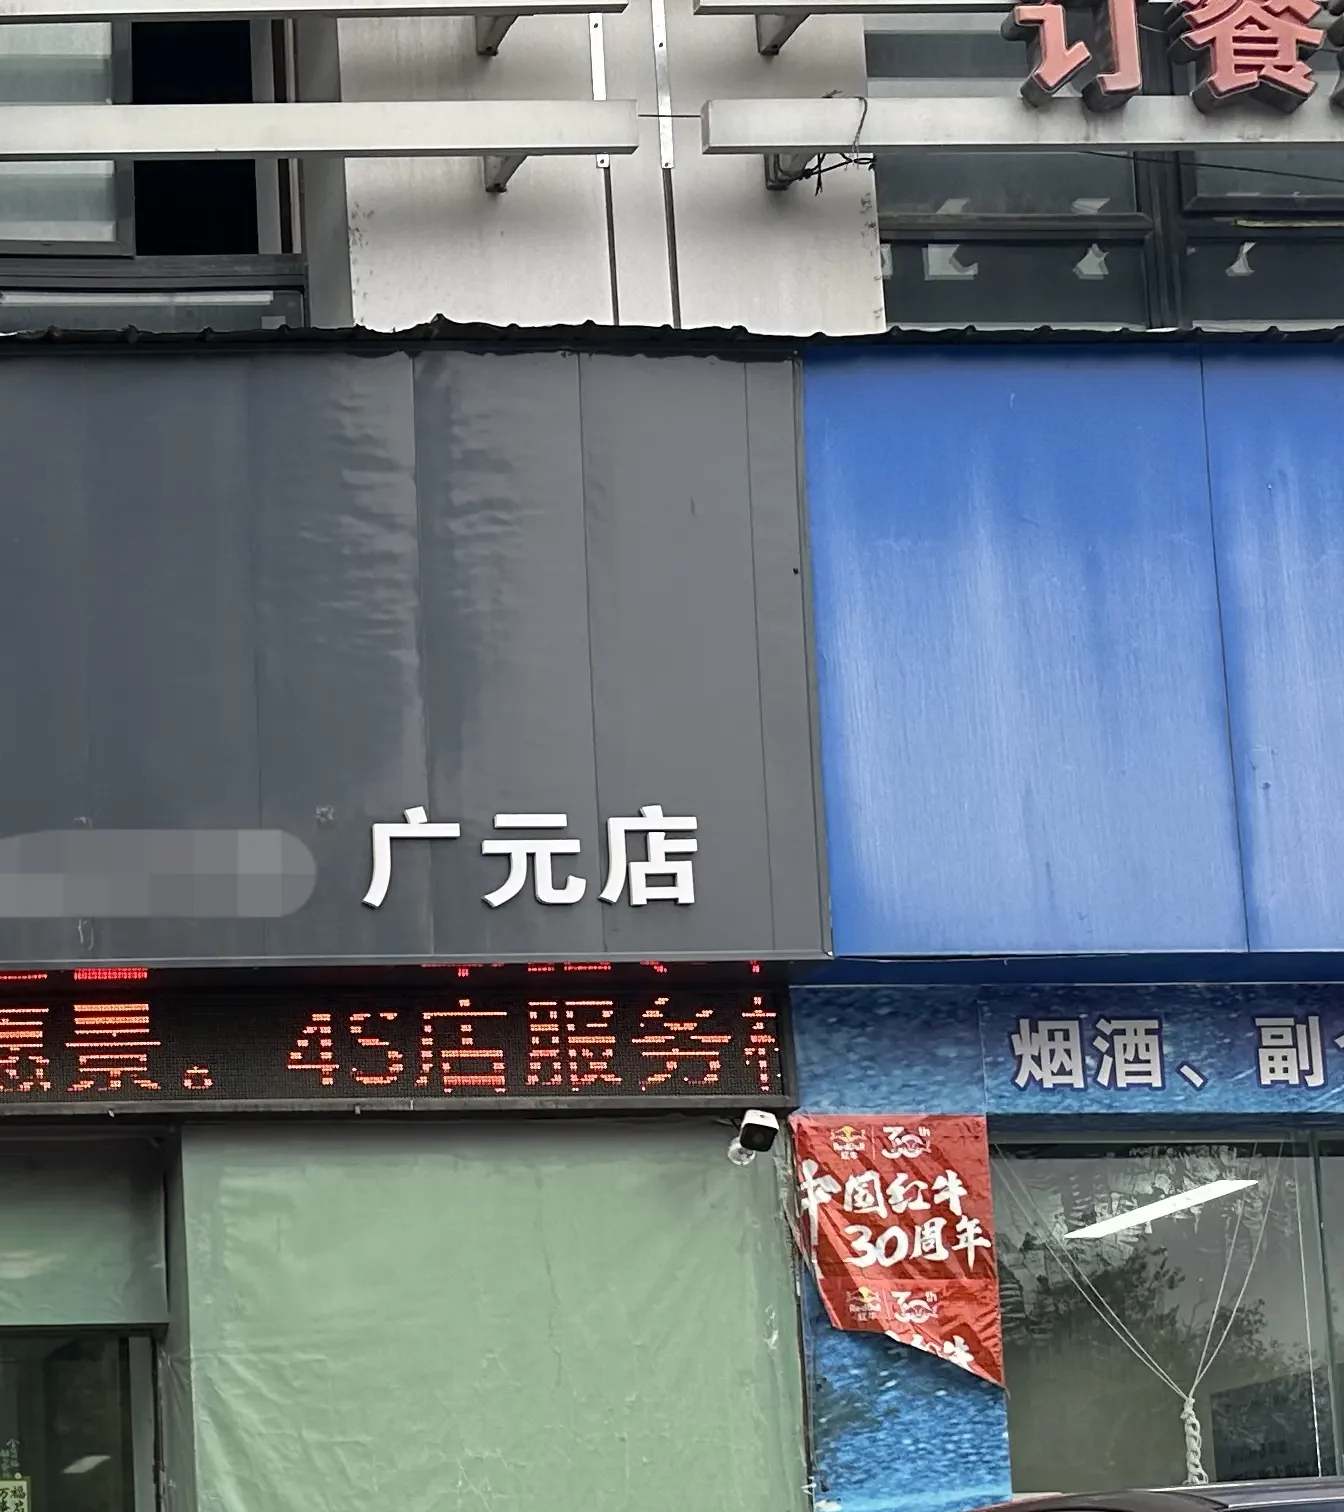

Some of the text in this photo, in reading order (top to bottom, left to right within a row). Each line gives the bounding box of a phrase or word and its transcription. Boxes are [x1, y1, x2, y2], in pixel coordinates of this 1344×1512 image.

[362, 805, 699, 909] 广元店
[1011, 1015, 1344, 1088] 烟酒、副
[800, 1159, 968, 1248] 中国红牛
[844, 1215, 992, 1272] 30周年
